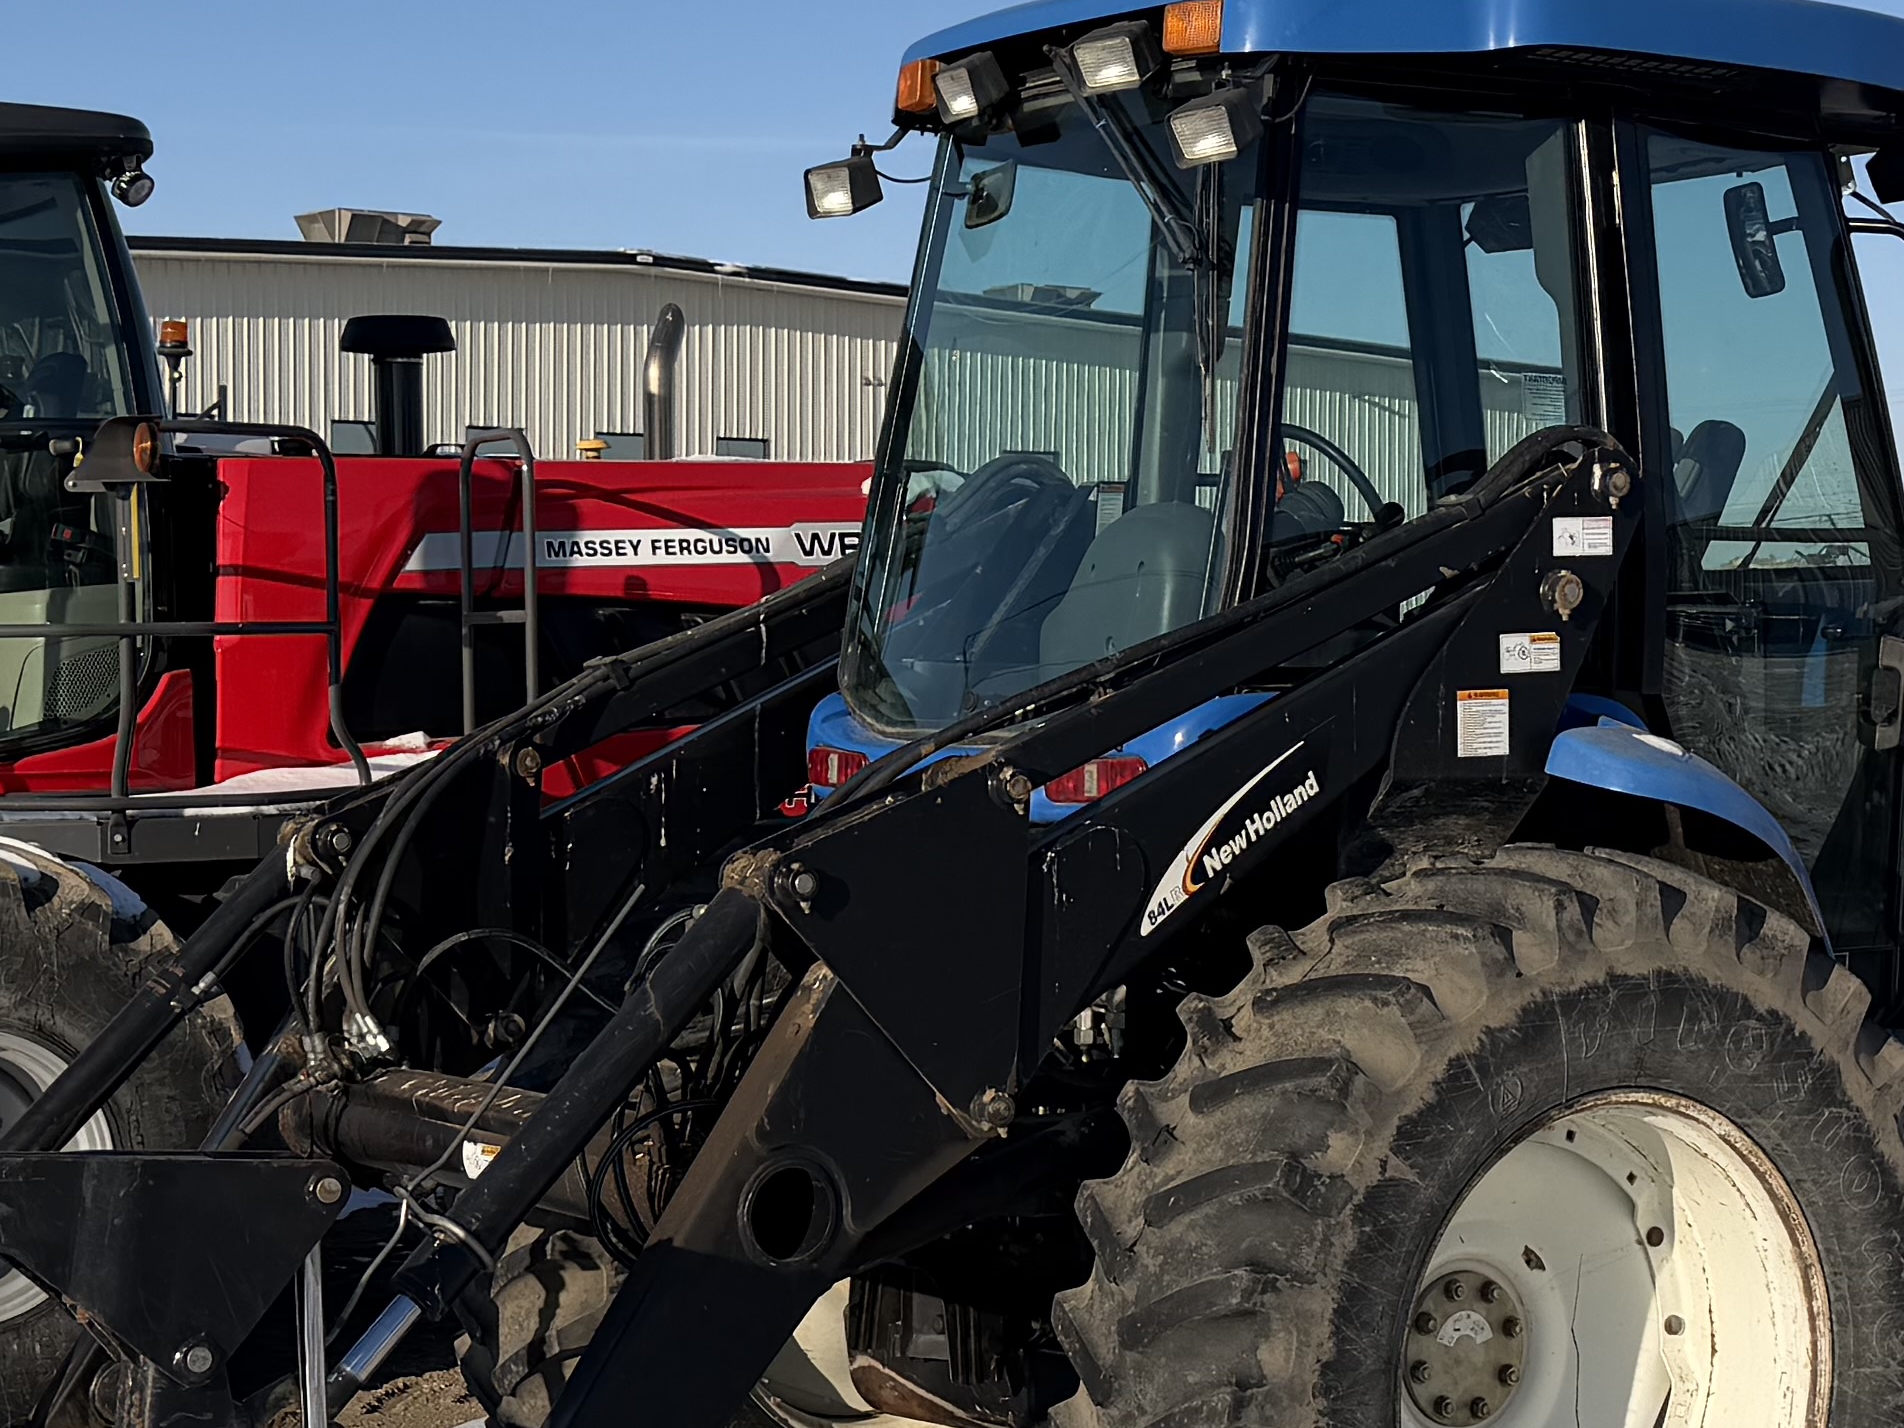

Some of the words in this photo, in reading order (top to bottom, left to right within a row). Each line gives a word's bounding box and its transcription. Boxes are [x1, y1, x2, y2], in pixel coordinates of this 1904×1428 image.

[546, 538, 642, 558] MASSEY
[651, 536, 771, 557] FERGUSON
[1202, 829, 1247, 878] New
[1245, 770, 1319, 842] Holland
